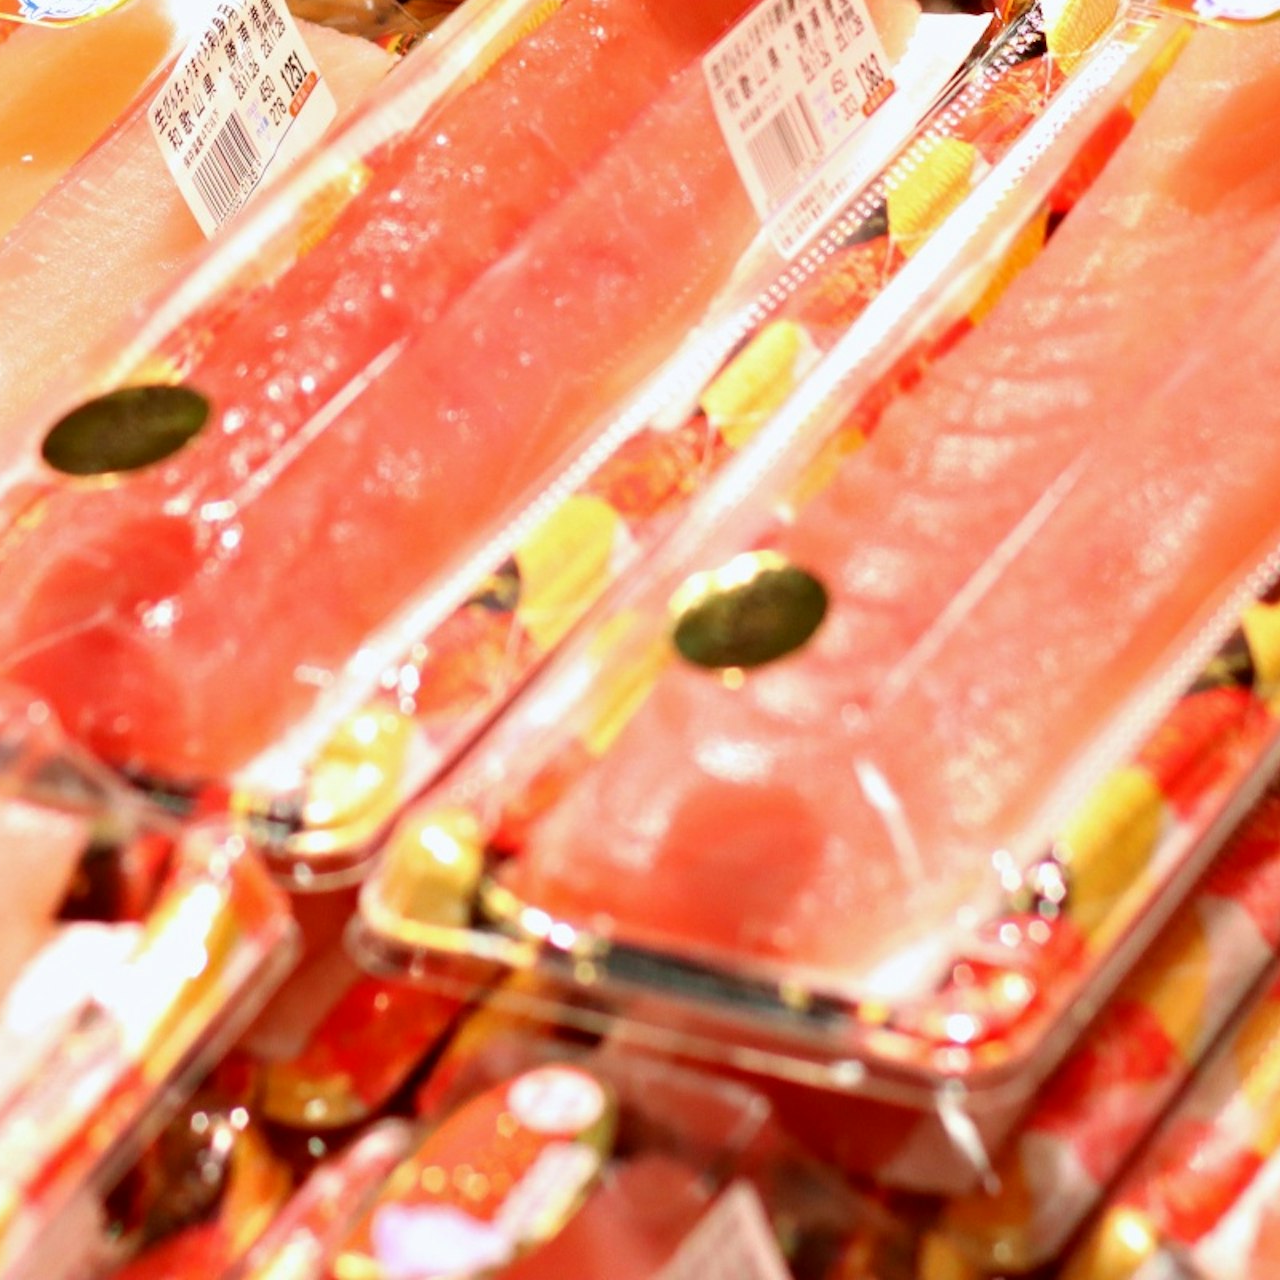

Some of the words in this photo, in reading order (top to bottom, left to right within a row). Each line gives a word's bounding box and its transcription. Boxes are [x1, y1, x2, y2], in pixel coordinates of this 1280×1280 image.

[281, 51, 308, 97] 1251
[259, 76, 276, 107] 450
[270, 97, 287, 127] 278
